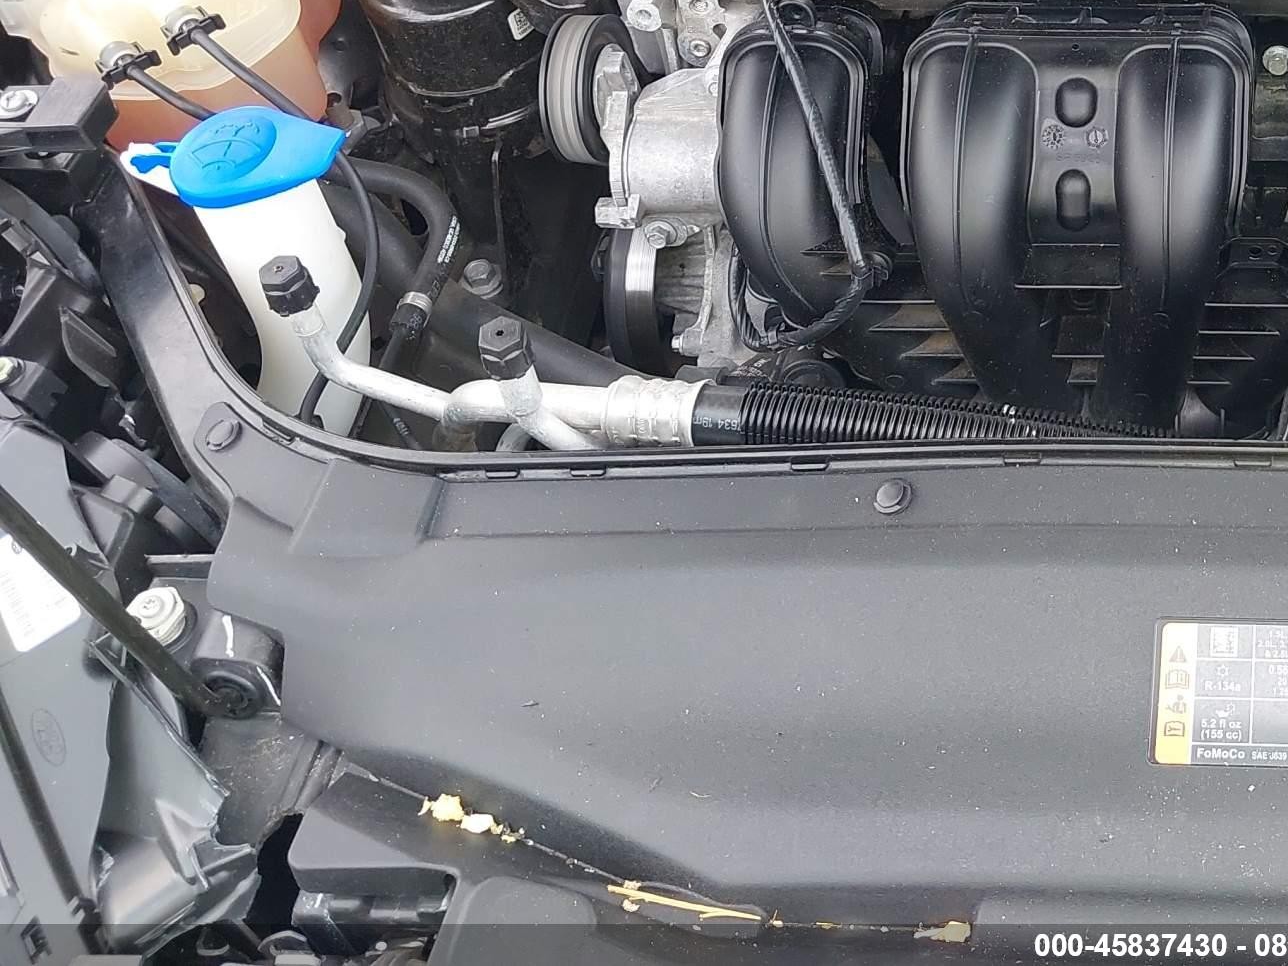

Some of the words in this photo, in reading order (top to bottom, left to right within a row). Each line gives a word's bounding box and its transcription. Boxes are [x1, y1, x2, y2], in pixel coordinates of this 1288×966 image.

[1204, 680, 1241, 692] R-134a
[1200, 718, 1217, 729] 5.2
[1219, 718, 1227, 729] fl
[1229, 720, 1242, 729] oz
[1200, 729, 1223, 741] (155
[1196, 747, 1246, 760] FoMoCo
[1251, 751, 1268, 760] SAE
